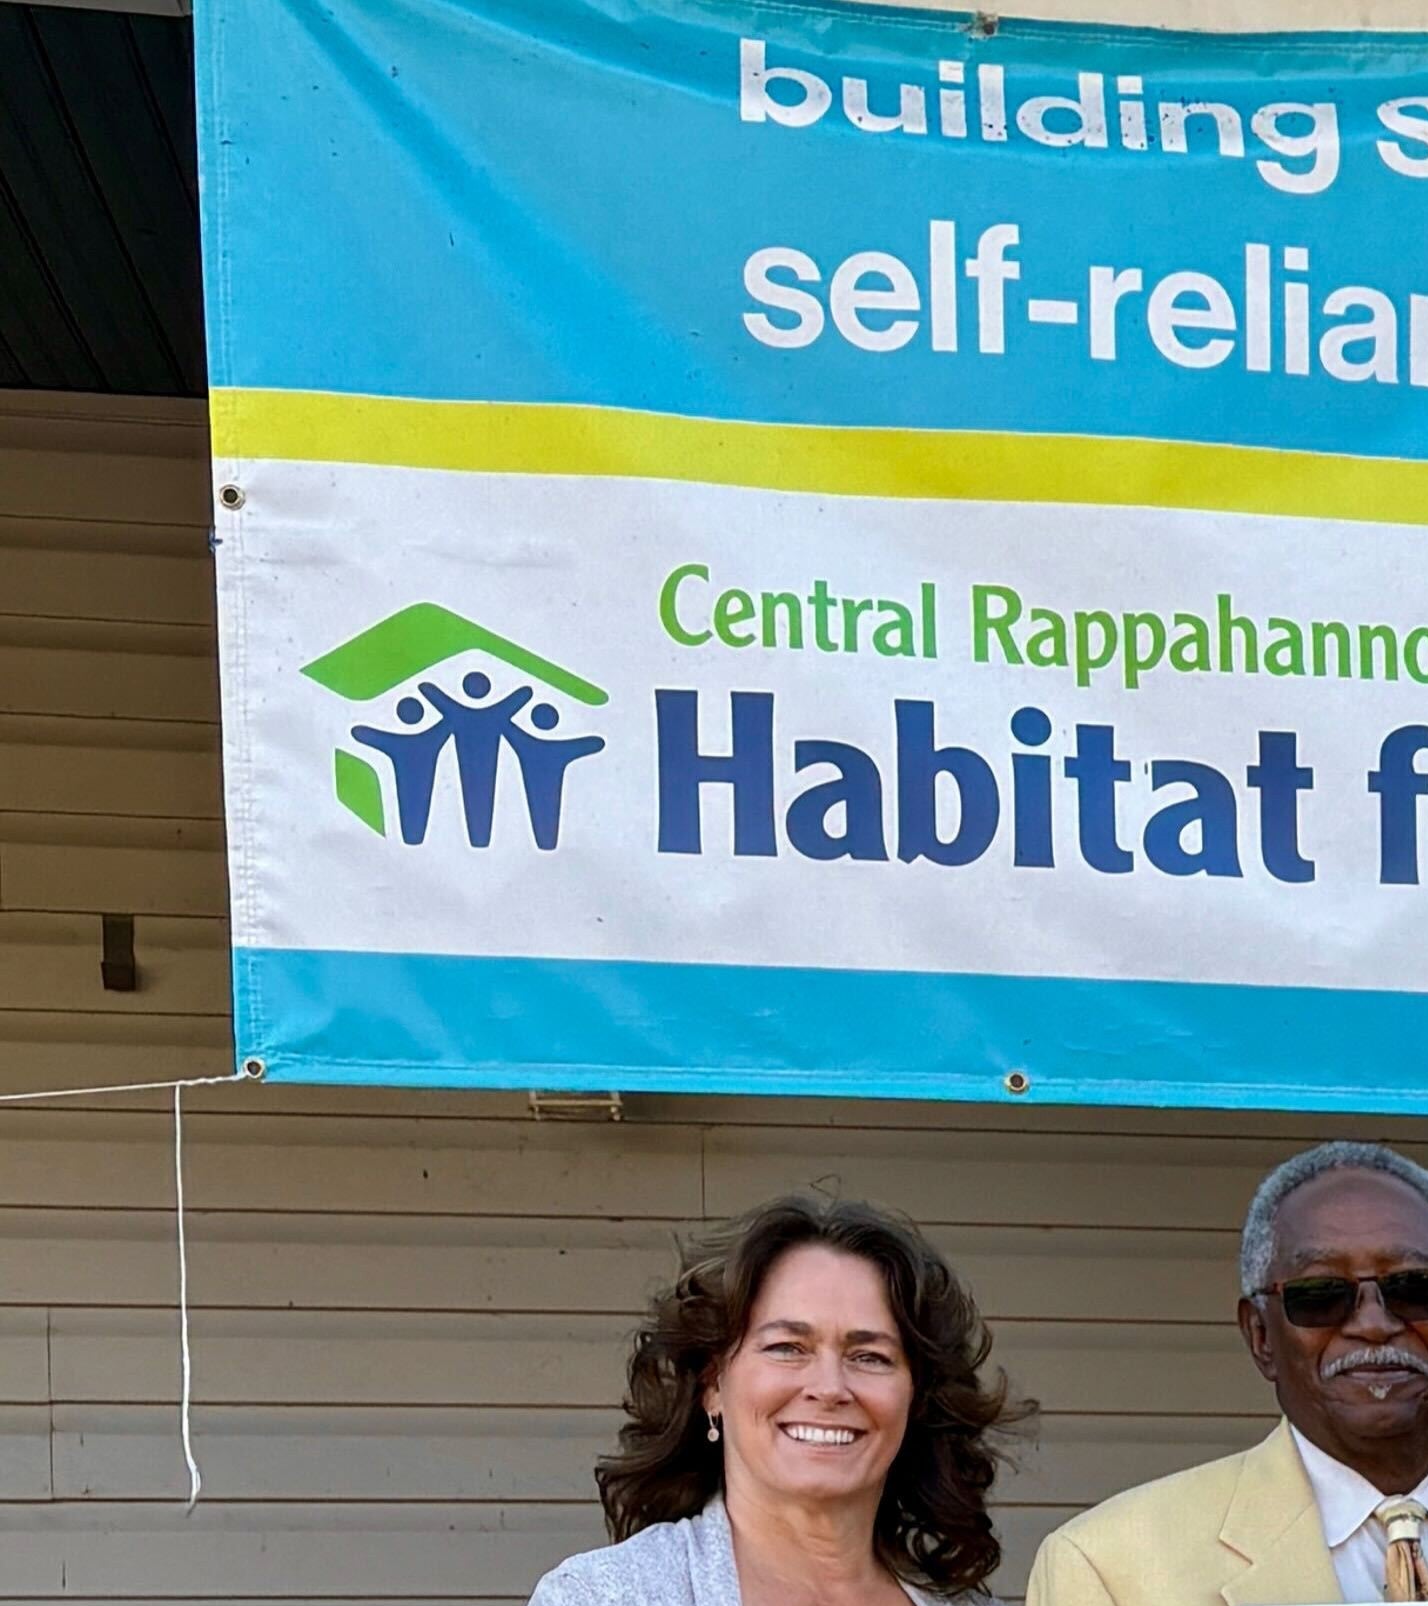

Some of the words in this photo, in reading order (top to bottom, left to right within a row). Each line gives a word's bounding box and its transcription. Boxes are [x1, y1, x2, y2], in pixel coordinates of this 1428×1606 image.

[741, 39, 1339, 194] building
[659, 564, 936, 658] Central
[655, 689, 1314, 884] Habitat
